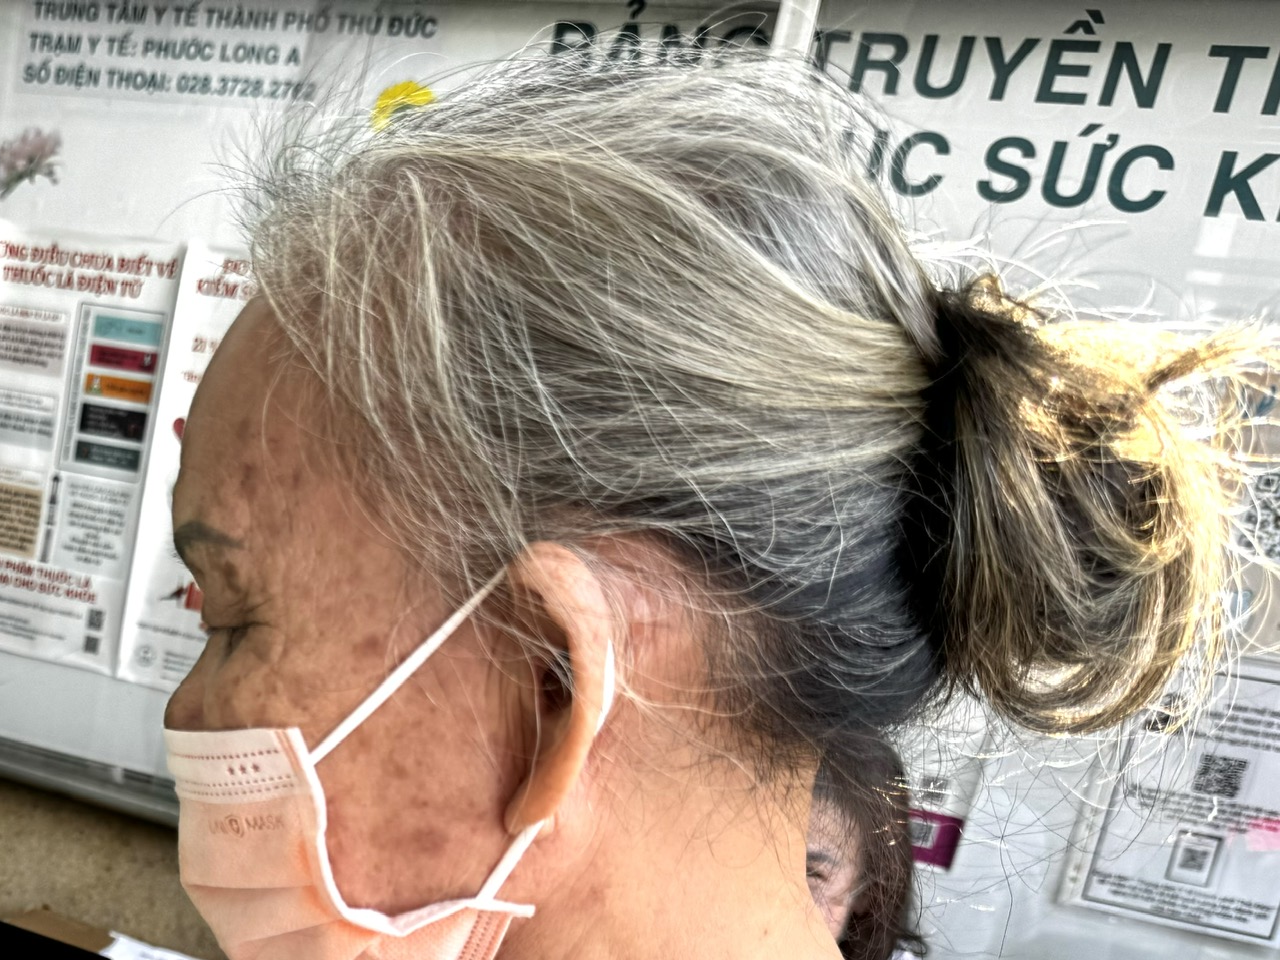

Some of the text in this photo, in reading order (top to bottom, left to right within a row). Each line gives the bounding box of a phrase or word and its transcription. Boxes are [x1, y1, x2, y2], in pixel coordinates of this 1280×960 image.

[153, 5, 168, 26] Y
[29, 33, 82, 57] TRẠM
[87, 37, 100, 53] Y
[142, 36, 216, 62] PHƯỚC
[219, 43, 280, 66] LONG
[284, 47, 300, 67] A
[814, 9, 1173, 110] TRUYỀN
[1207, 45, 1280, 116] T
[22, 58, 51, 85] SỐ
[54, 63, 100, 90] ĐIỆN
[976, 124, 1176, 213] SỨC
[1203, 150, 1280, 222] K
